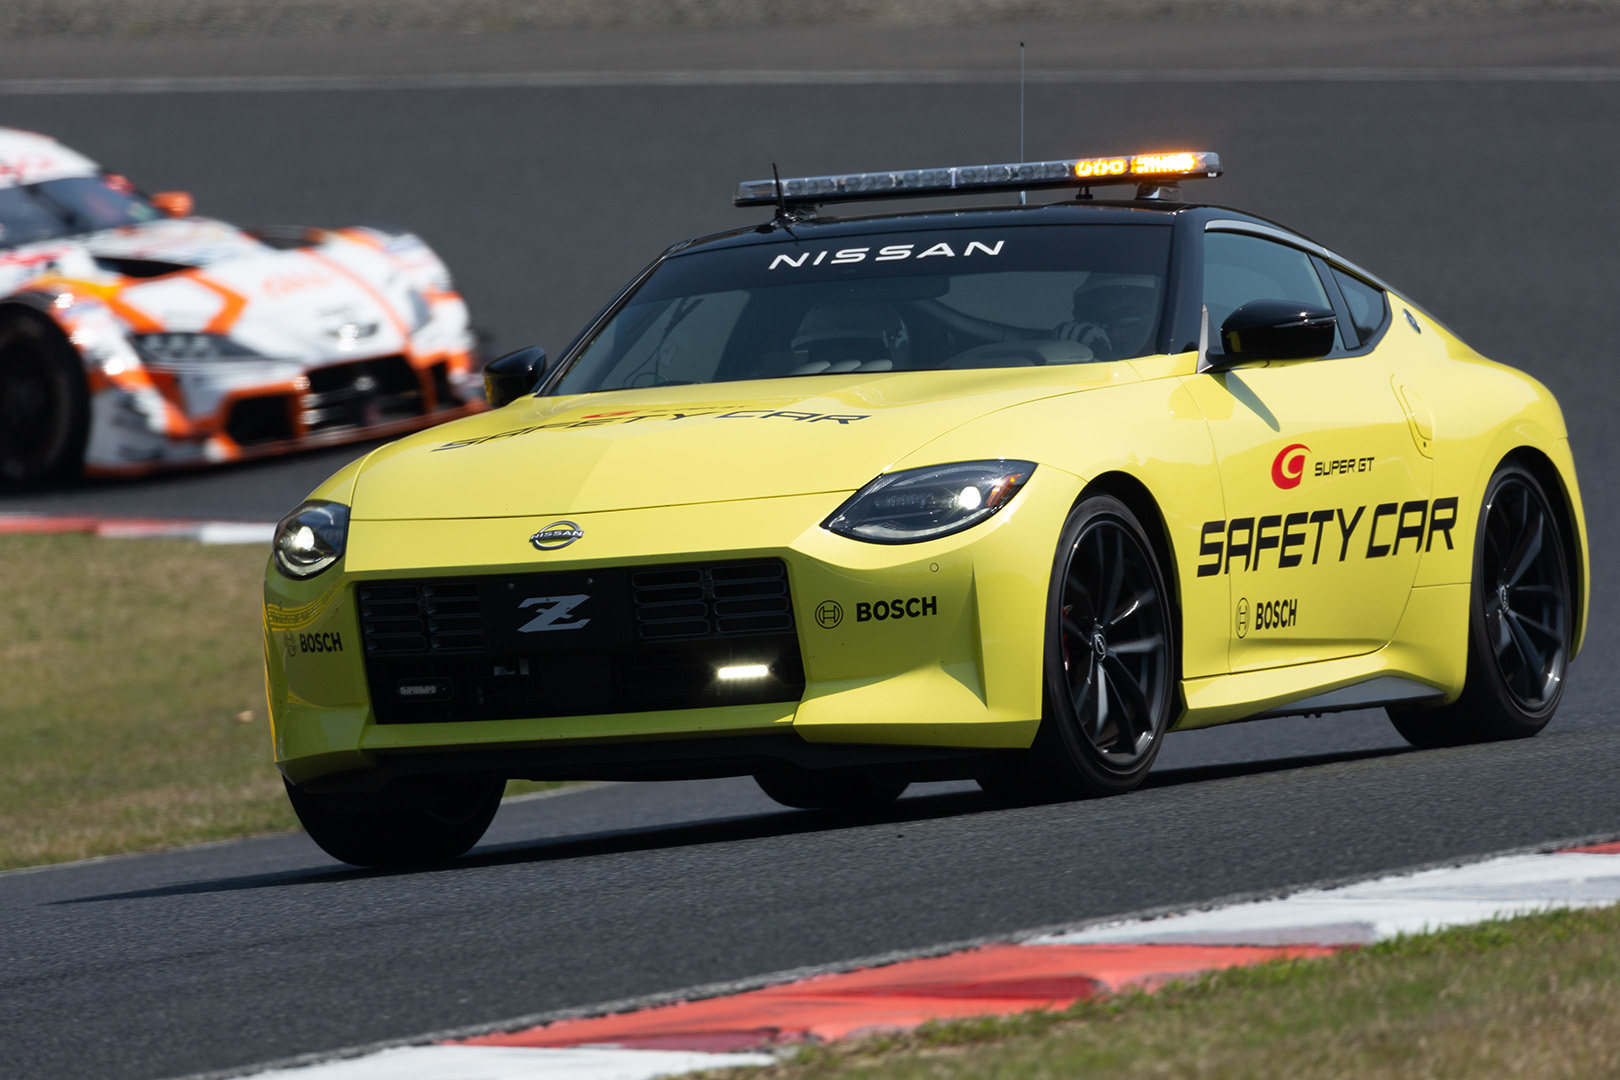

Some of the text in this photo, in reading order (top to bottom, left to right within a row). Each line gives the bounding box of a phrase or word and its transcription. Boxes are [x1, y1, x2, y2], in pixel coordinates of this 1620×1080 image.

[768, 240, 1005, 270] NISSAN
[430, 409, 872, 452] SAFETY CAR
[1314, 456, 1375, 477] SUPER GT
[530, 530, 585, 541] NISSAN
[1196, 496, 1459, 578] SAFETY CAR
[517, 593, 591, 633] Z
[856, 595, 938, 622] BOSCH
[1255, 598, 1298, 630] BOSCH
[299, 631, 343, 653] BOSCH
